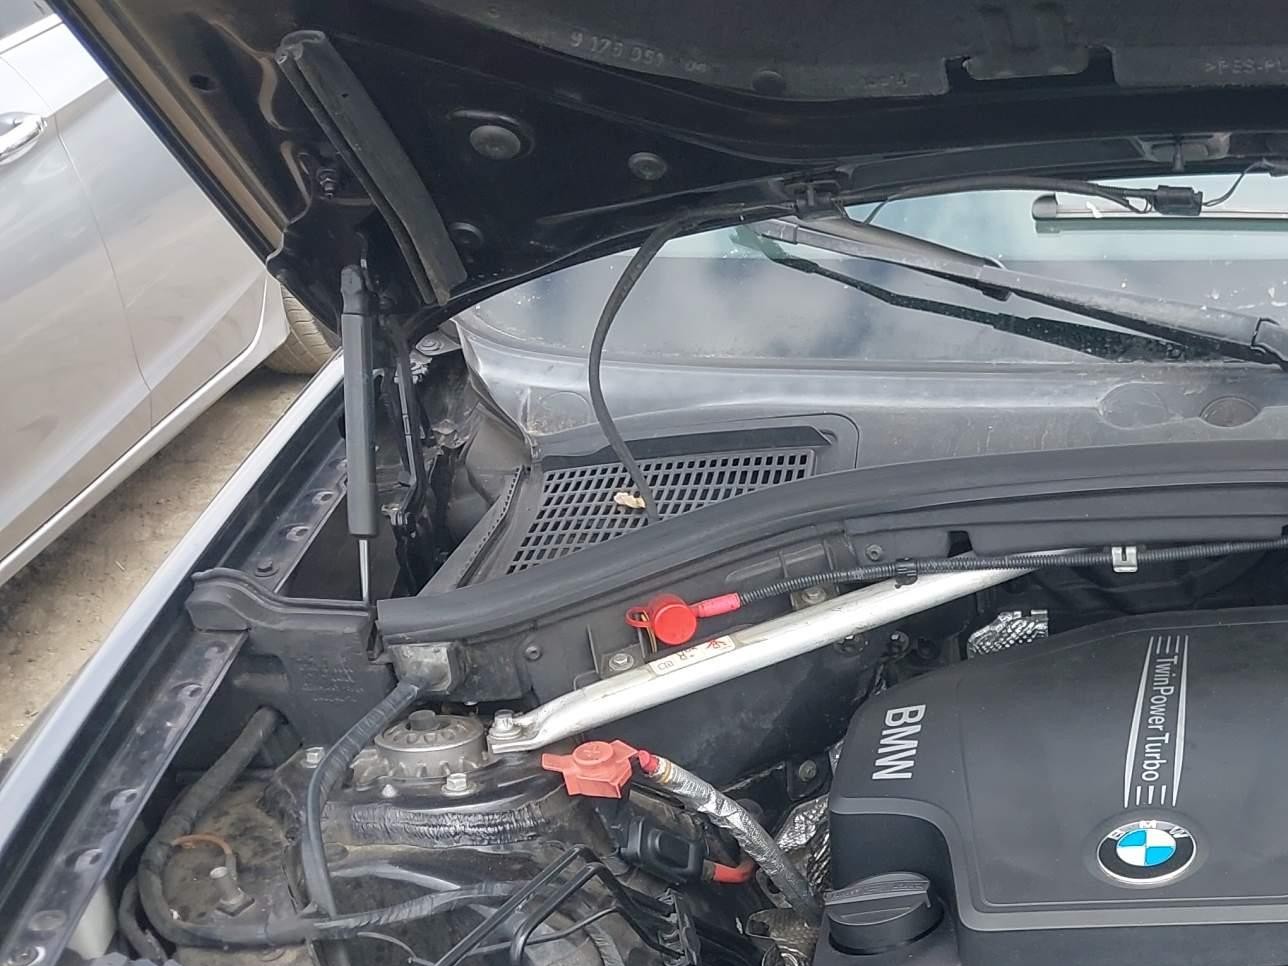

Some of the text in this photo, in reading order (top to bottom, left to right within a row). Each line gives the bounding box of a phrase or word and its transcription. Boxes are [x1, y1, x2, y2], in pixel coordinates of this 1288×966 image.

[872, 704, 926, 779] BMW
[1141, 655, 1179, 781] TwinPower Turbo
[1107, 819, 1192, 840] BMW
